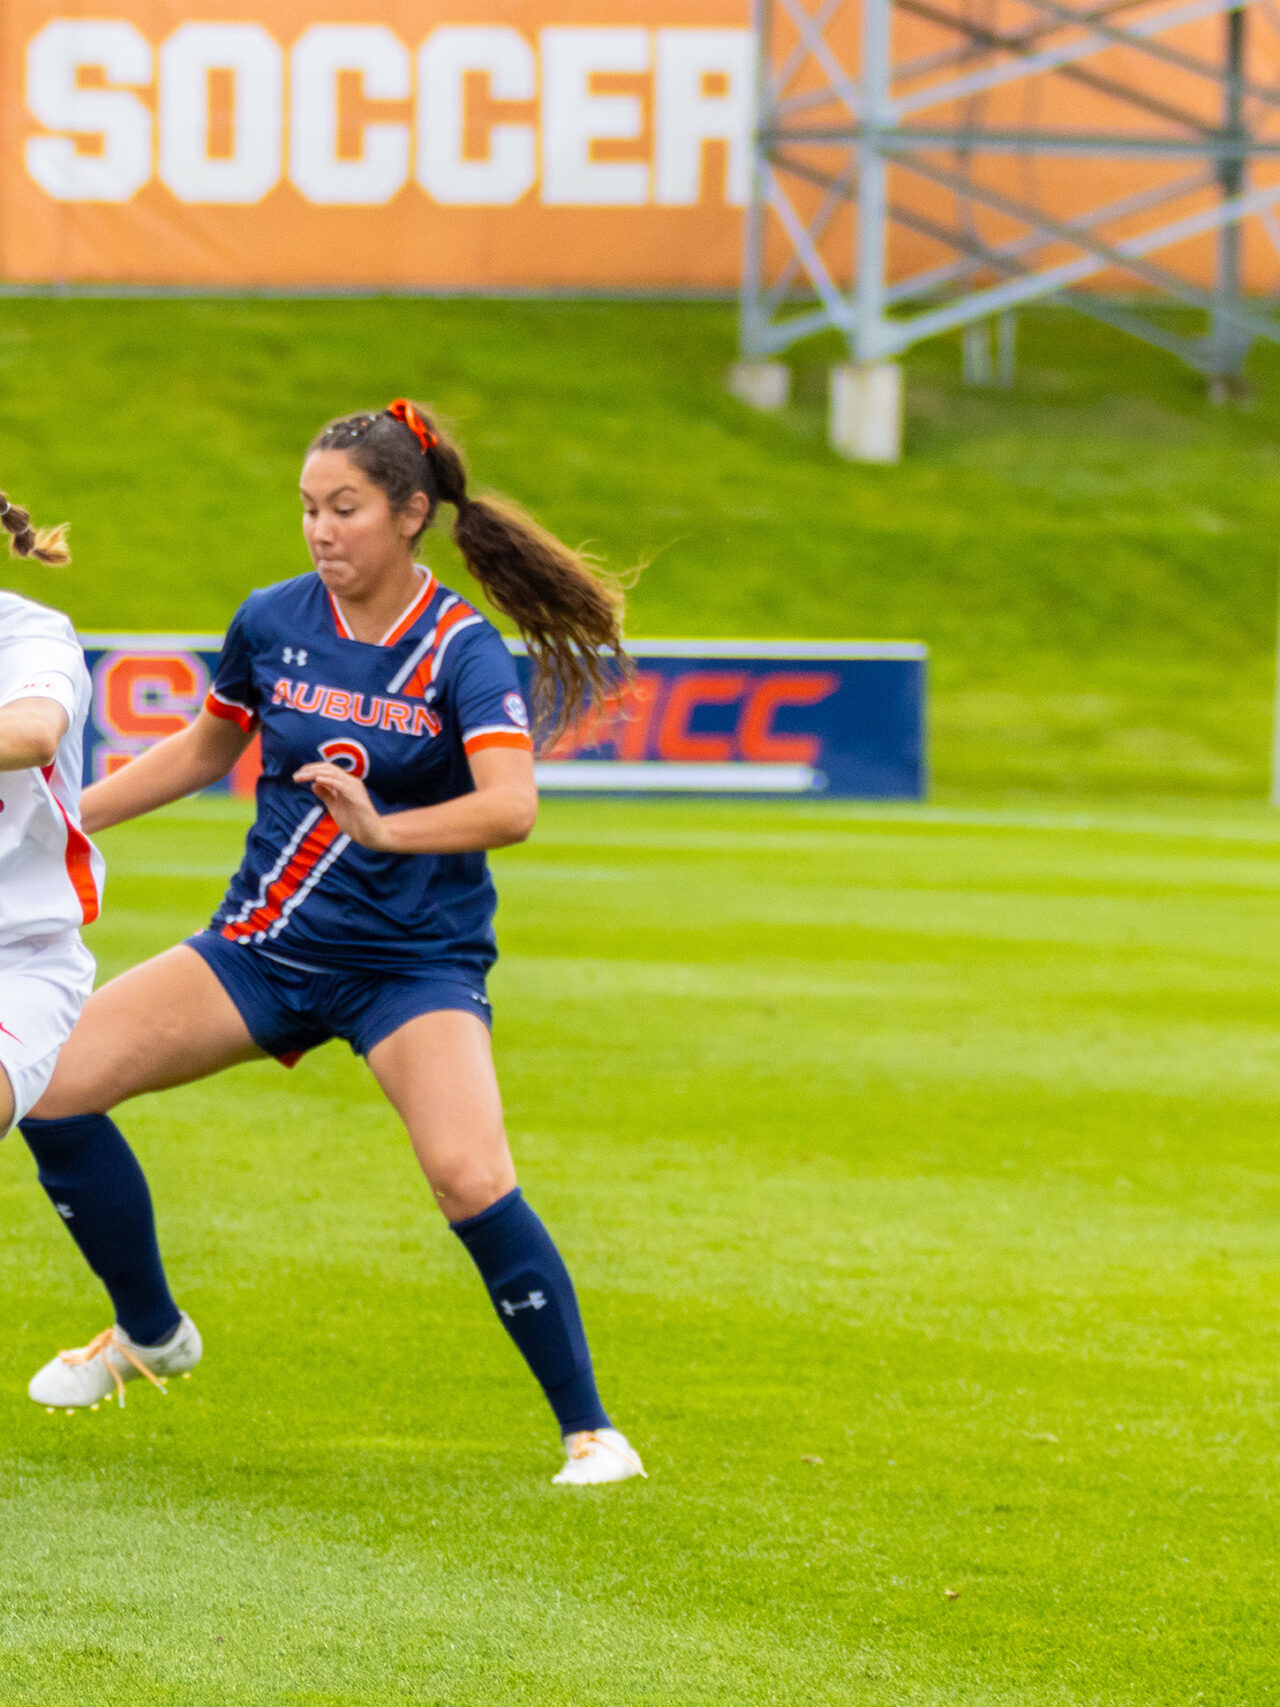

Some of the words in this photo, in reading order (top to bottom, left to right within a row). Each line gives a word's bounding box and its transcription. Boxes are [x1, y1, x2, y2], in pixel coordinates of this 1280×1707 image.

[24, 18, 758, 208] SOCCER
[272, 676, 443, 738] AUBURN
[538, 668, 842, 764] ACC
